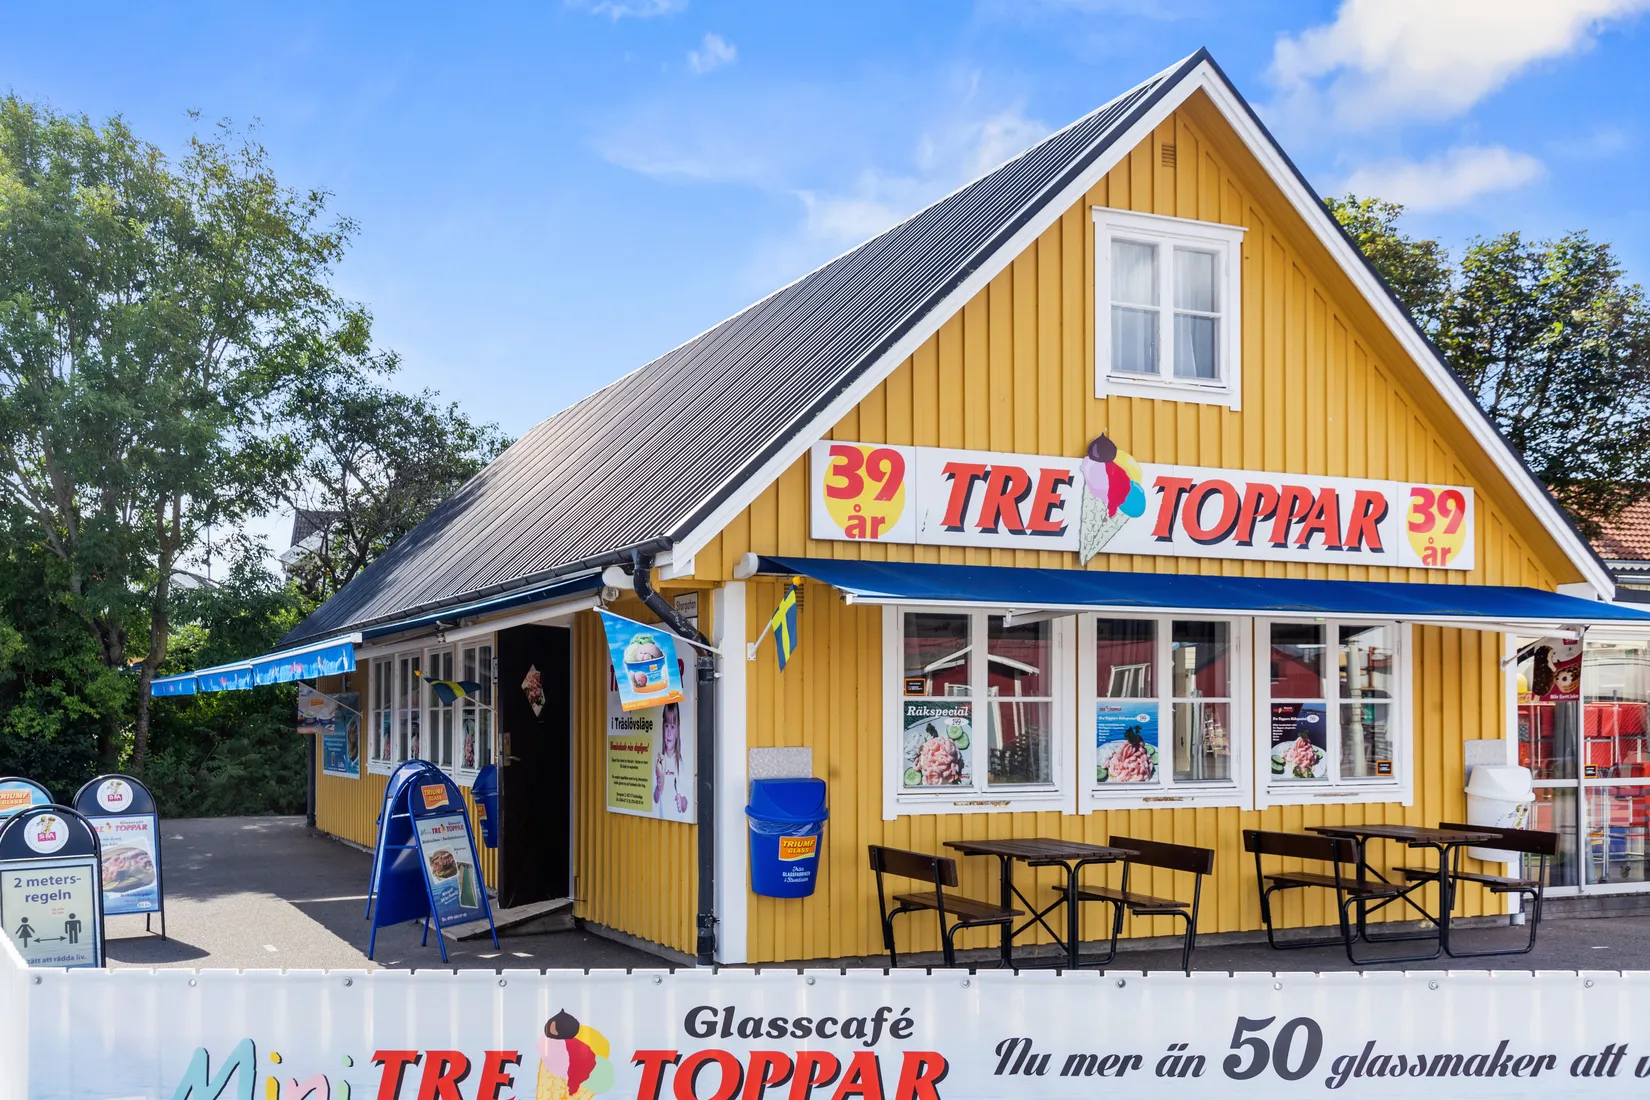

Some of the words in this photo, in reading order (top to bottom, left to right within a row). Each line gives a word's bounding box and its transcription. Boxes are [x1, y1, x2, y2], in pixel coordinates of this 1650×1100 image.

[826, 445, 906, 501] 39
[844, 504, 886, 540] år
[940, 461, 1075, 537] TRE
[1151, 475, 1388, 553] TOPPAR
[1408, 487, 1466, 535] 39
[1421, 537, 1452, 567] år
[615, 717, 653, 733] Träslövsläge
[906, 705, 969, 718] Räkspecial
[0, 792, 29, 800] RIUMF
[783, 840, 815, 848] TRIUMF
[13, 877, 22, 888] 2
[26, 875, 82, 888] meters-
[25, 889, 72, 904] regeln
[684, 1005, 914, 1047] Glasscafé
[993, 1037, 1052, 1077] Nu
[1059, 1051, 1144, 1078] mer
[1155, 1043, 1207, 1078] än
[1222, 1016, 1323, 1081] 50
[1324, 1040, 1557, 1089] glassmaker
[1569, 1043, 1629, 1078] att
[371, 1050, 521, 1100] TRE
[630, 1049, 949, 1100] TOPPAR
